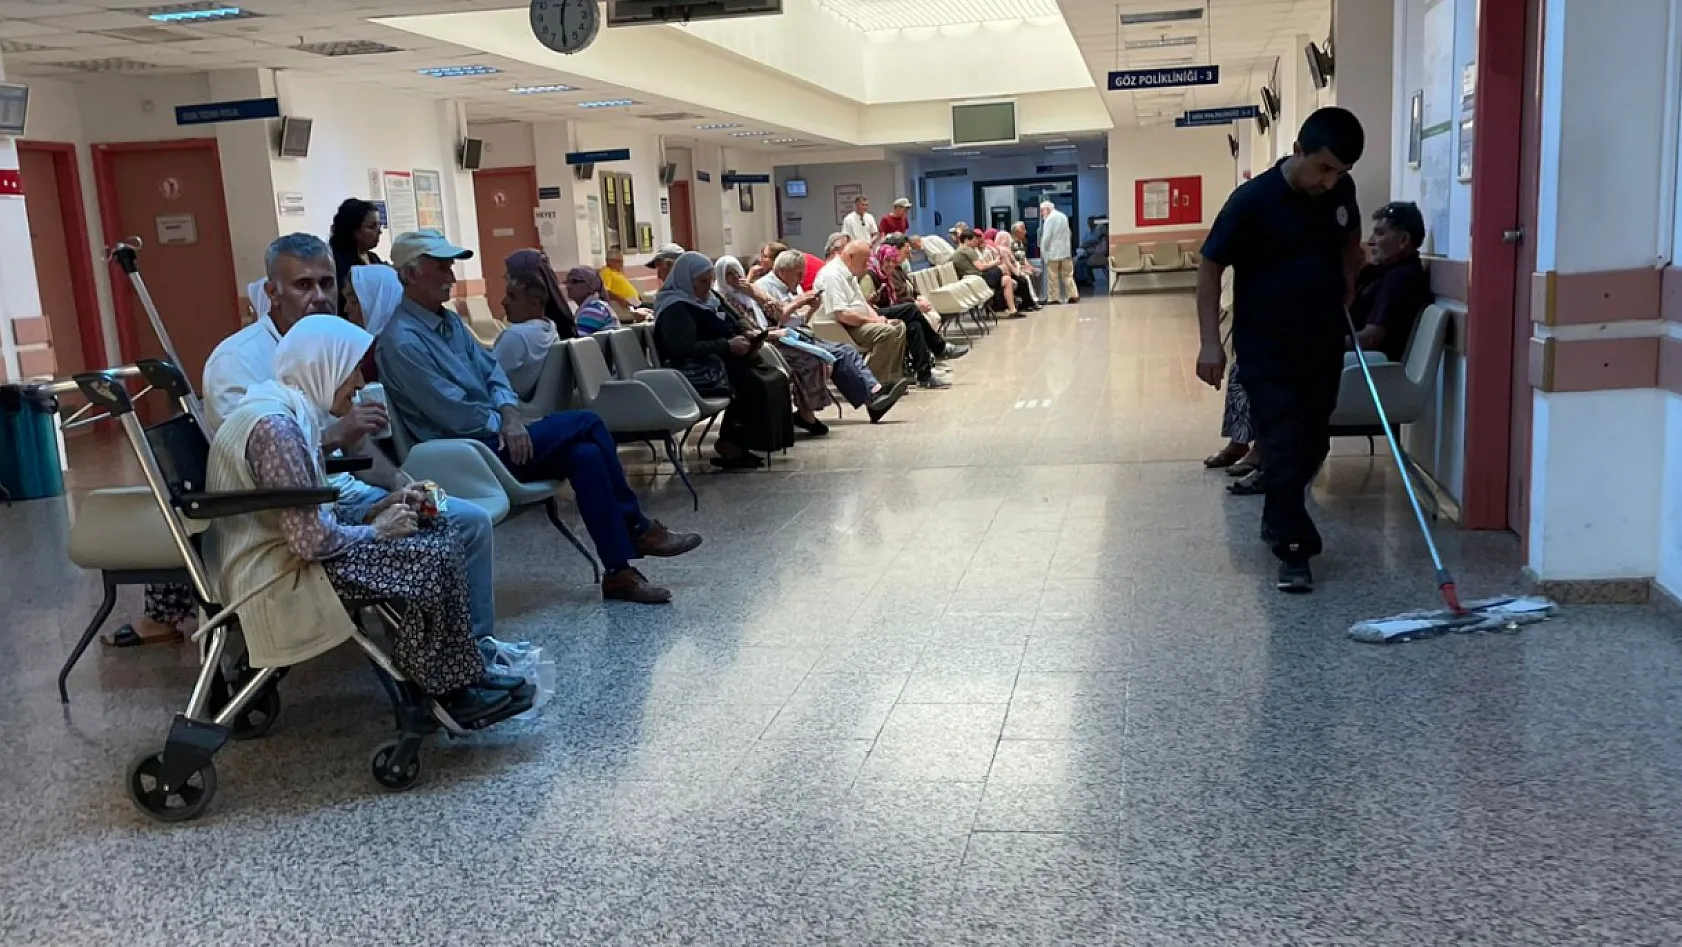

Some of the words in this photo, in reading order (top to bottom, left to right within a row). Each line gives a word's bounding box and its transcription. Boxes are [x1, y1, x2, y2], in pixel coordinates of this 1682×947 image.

[1115, 74, 1137, 87] GÖZ
[1138, 69, 1198, 85] POLİKLİNİĞİ
[1206, 70, 1212, 81] 3
